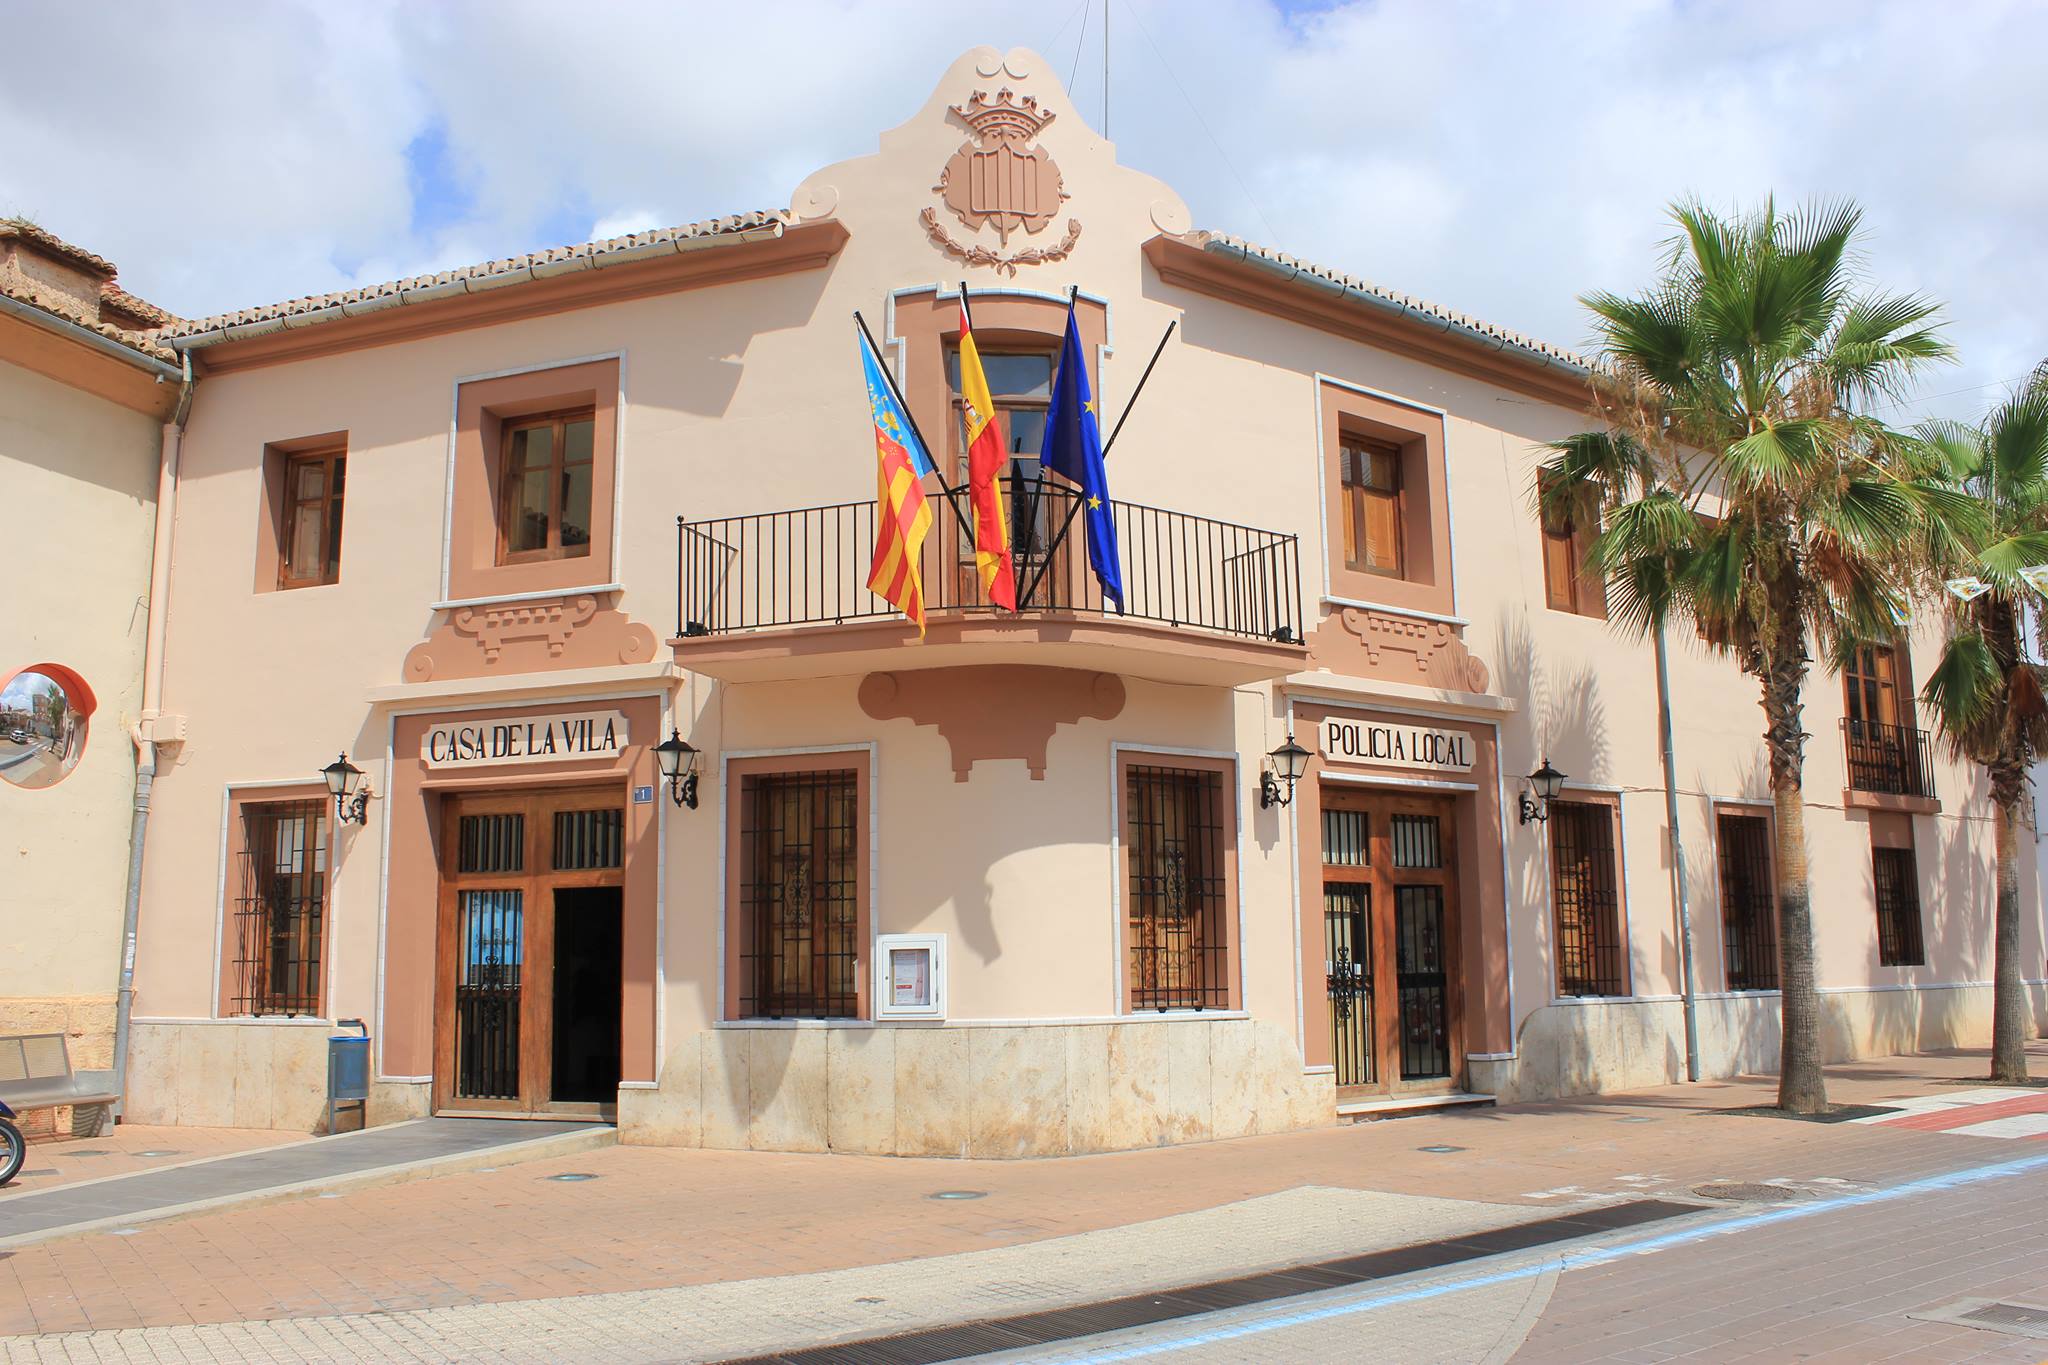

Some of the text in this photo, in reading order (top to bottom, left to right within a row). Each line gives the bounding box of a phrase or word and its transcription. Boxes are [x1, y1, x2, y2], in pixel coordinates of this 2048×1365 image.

[430, 717, 617, 763] CASA DE LA VILA
[1328, 722, 1471, 767] POLICIA LOCAL
